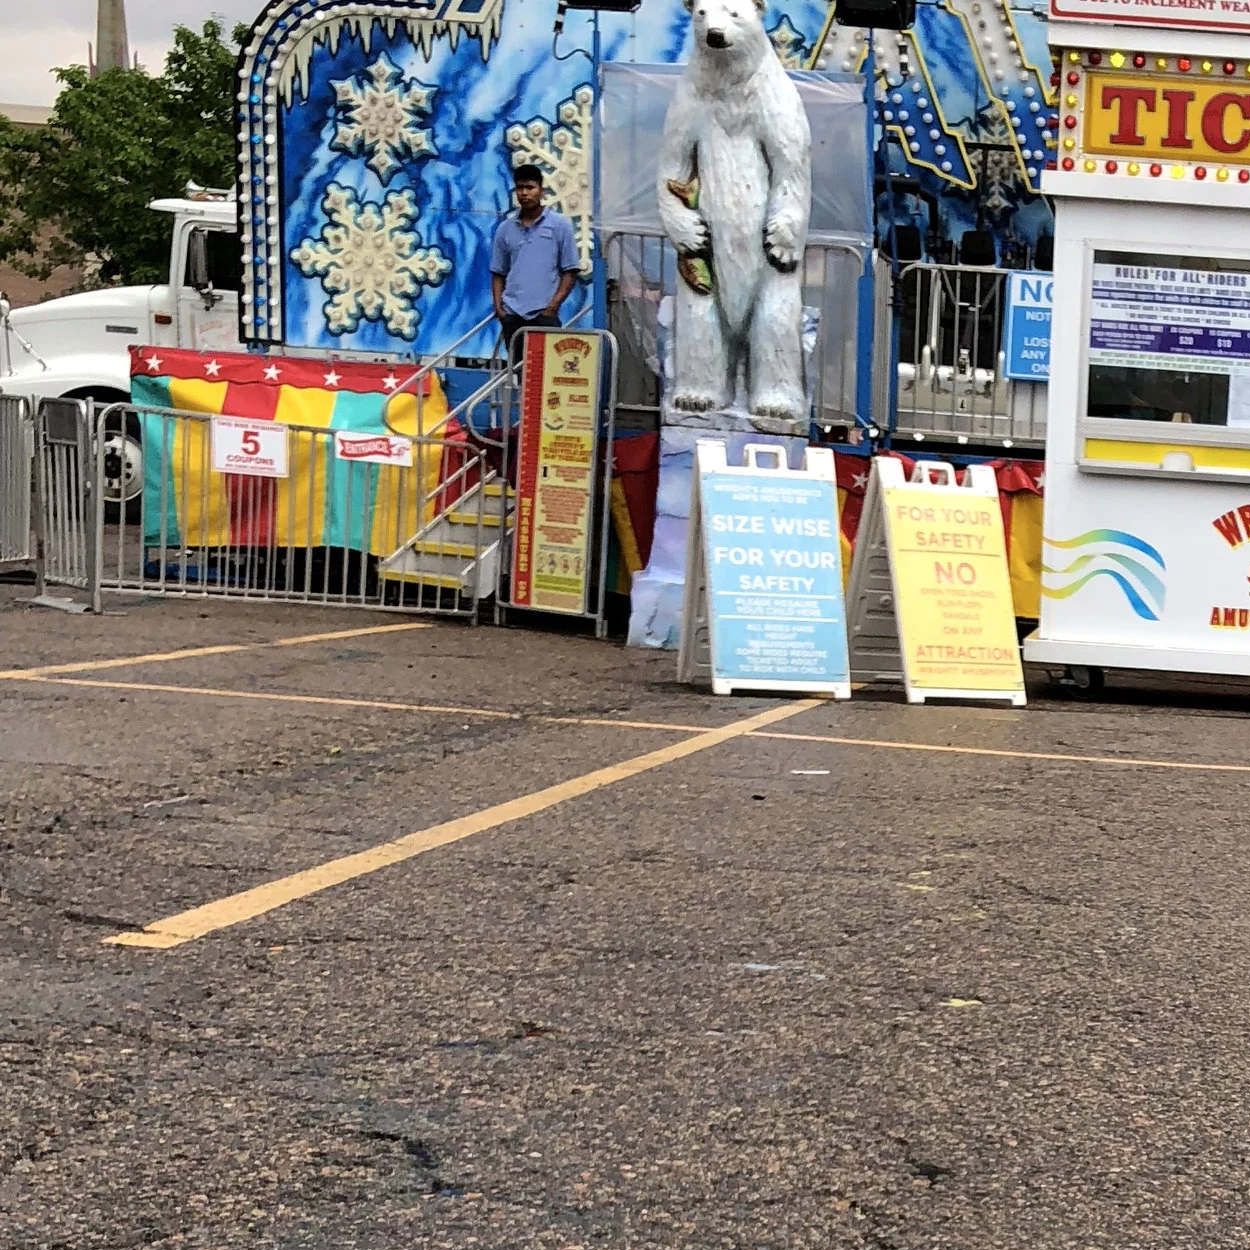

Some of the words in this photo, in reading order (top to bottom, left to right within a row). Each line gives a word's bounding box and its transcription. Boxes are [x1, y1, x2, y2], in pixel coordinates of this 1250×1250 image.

[1115, 267, 1149, 280] RULES
[1155, 270, 1176, 282] FOR
[1182, 271, 1201, 284] ALL
[1207, 274, 1247, 287] RIDERS
[1020, 349, 1047, 360] ANY
[241, 430, 261, 456] 5
[226, 454, 274, 466] COUPONS
[712, 514, 766, 535] SIZE
[770, 516, 832, 538] WISE
[896, 505, 936, 522] FOR
[940, 507, 992, 527] YOUR
[915, 531, 985, 550] SAFETY
[714, 546, 764, 567] FOR
[769, 548, 836, 569] YOUR
[739, 574, 815, 592] SAFETY
[933, 560, 978, 586] NO
[915, 644, 1015, 661] ATTRACTION
